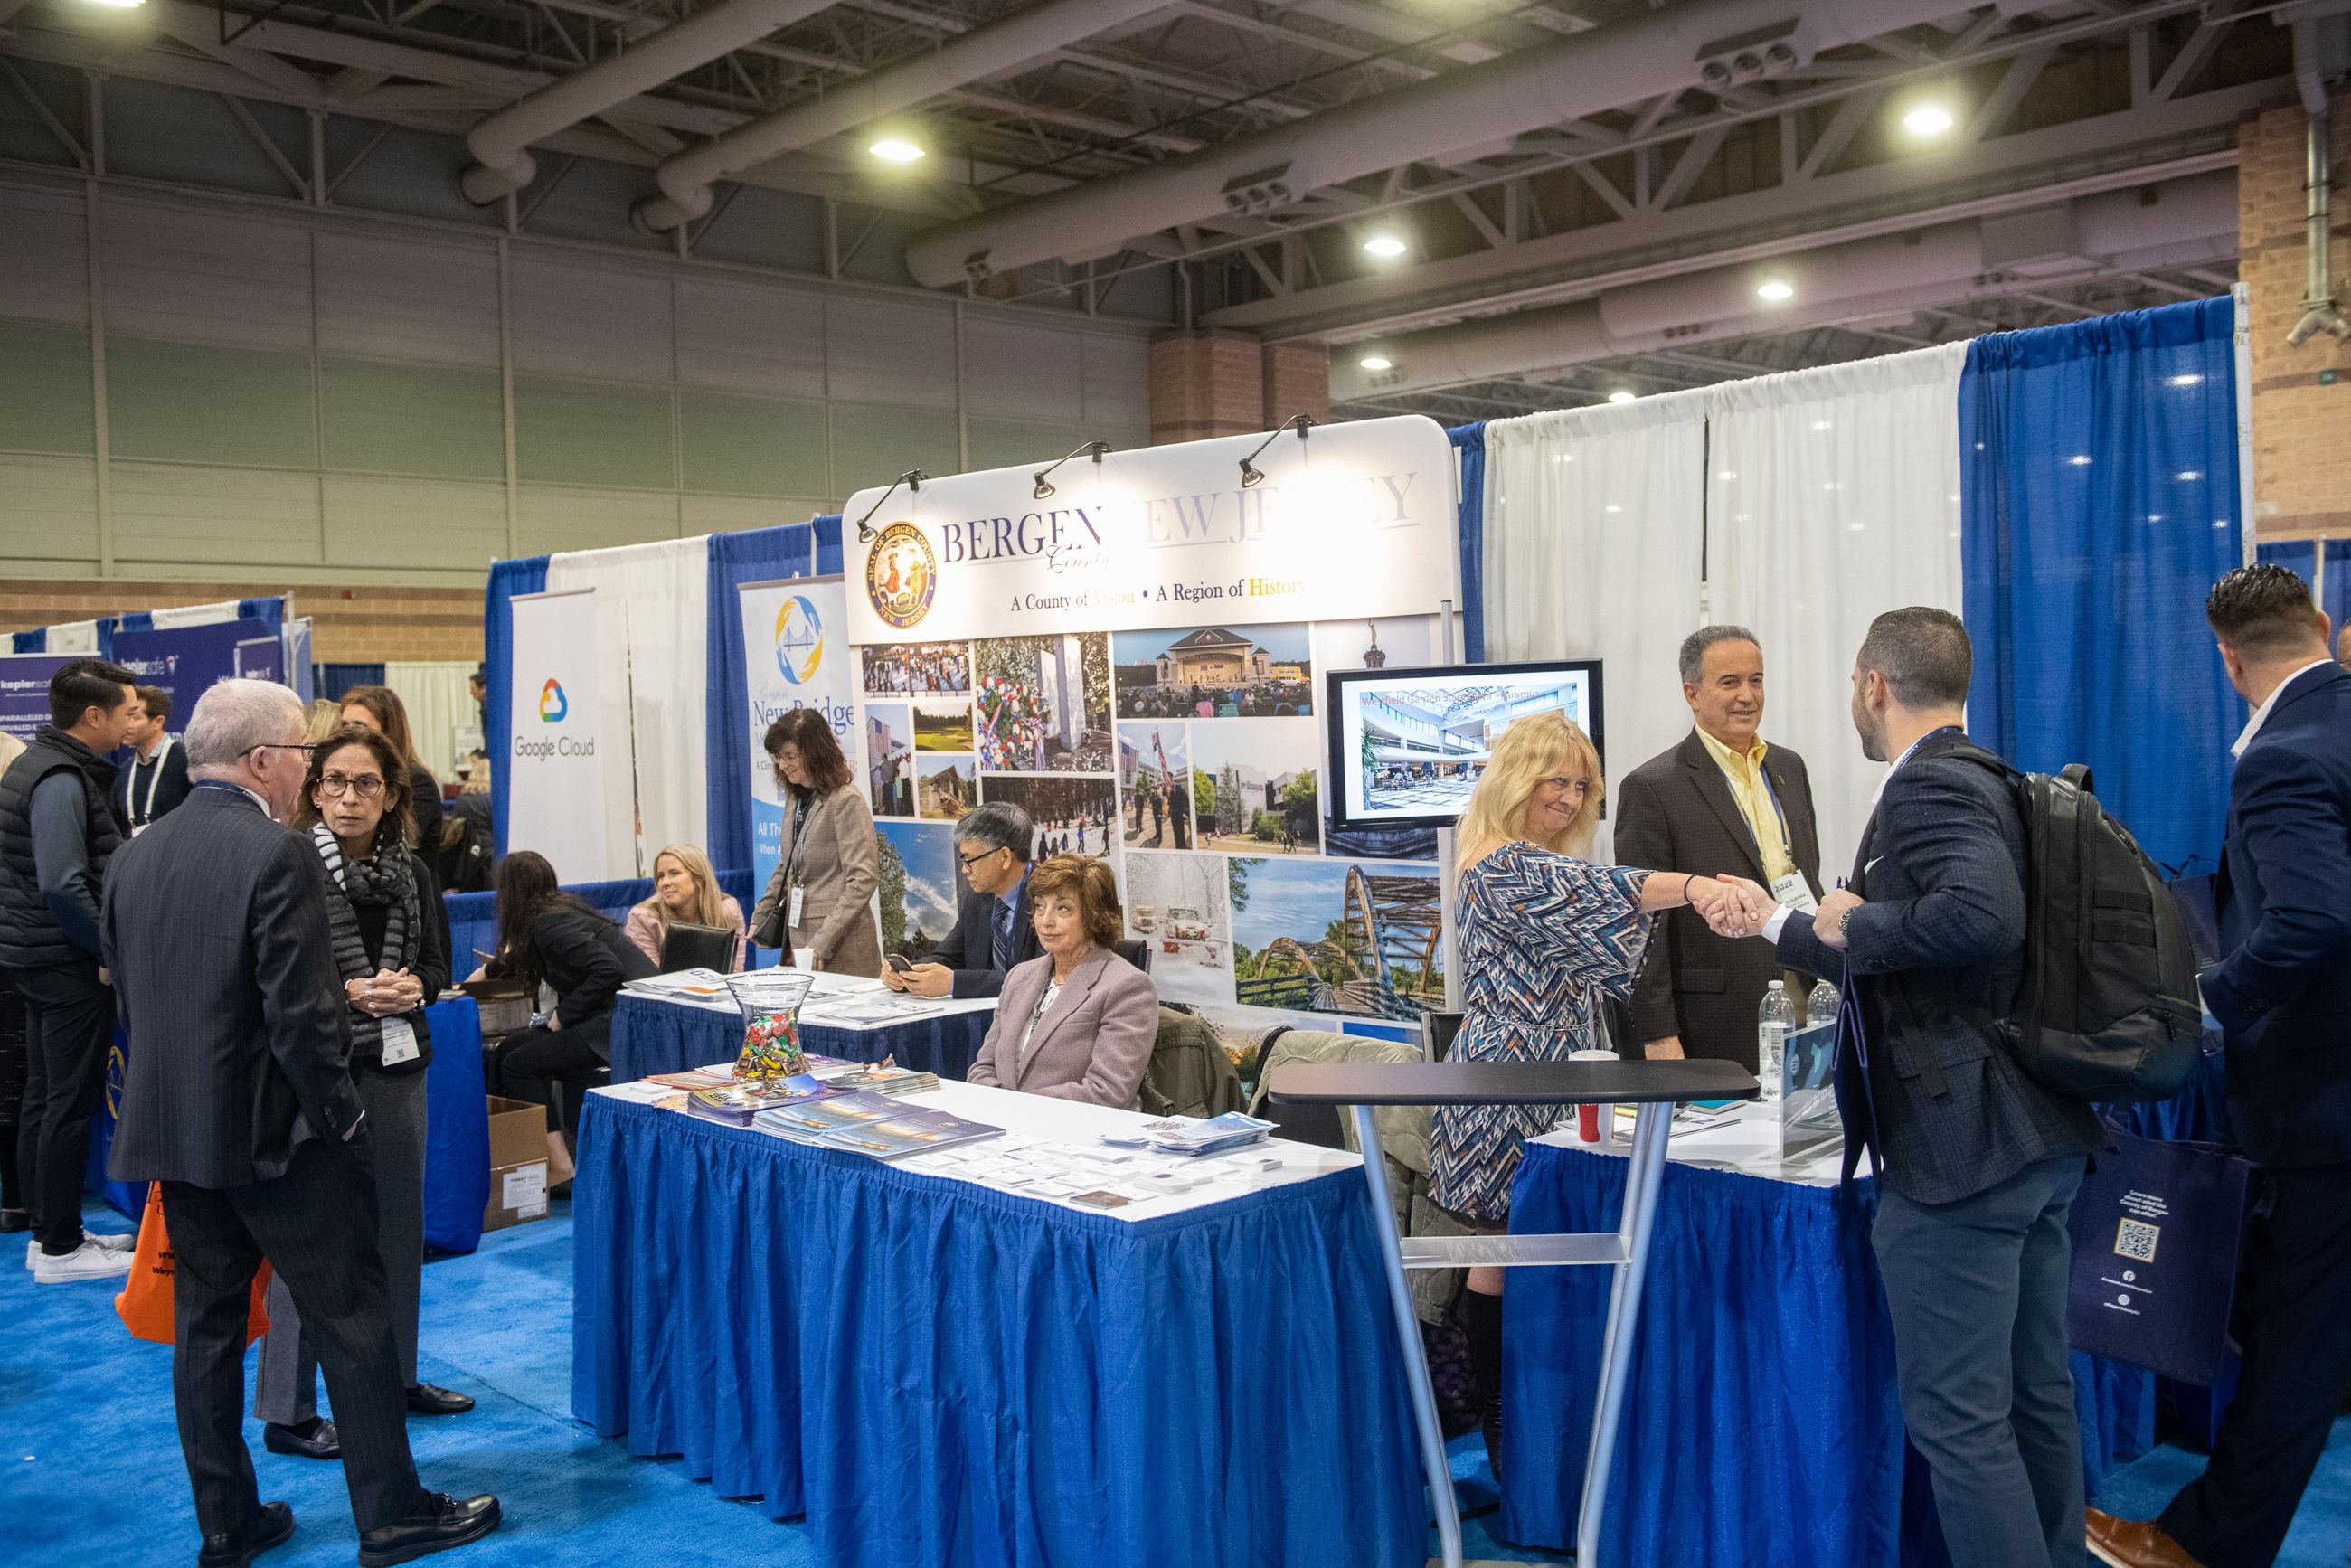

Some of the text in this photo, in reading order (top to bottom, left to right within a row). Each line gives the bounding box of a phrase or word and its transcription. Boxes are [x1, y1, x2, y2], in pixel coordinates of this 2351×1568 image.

[941, 506, 1102, 563] BERGEN
[1145, 491, 1221, 543] EW
[867, 524, 936, 581] SEAL OF BERGEN COUNTY
[1011, 595, 1022, 611] A
[1025, 593, 1072, 611] County
[1075, 589, 1090, 607] of
[1156, 585, 1168, 602] A
[1173, 581, 1223, 603] Region
[1228, 579, 1245, 597] of
[1248, 576, 1305, 598] History
[878, 602, 929, 627] NEW JERSEY
[1, 679, 52, 691] keplersaf
[753, 695, 854, 735] New dge
[515, 735, 594, 762] Google Cloud
[758, 822, 781, 837] All Th
[1774, 880, 1794, 893] 2022
